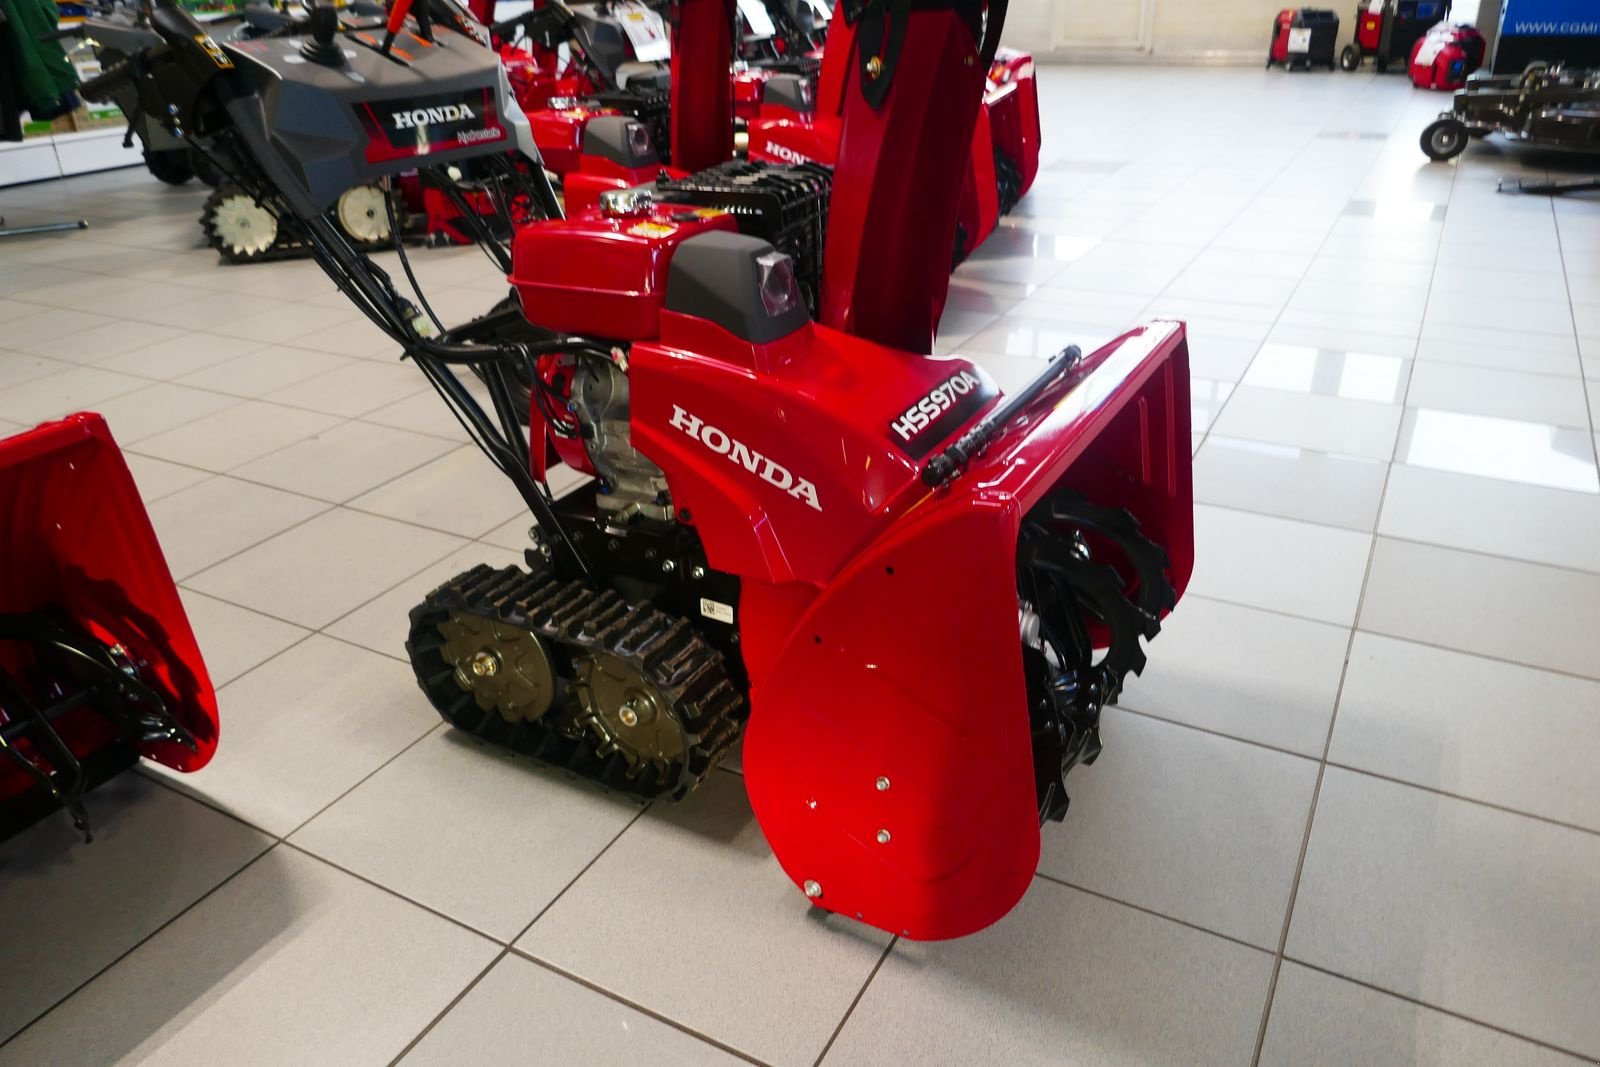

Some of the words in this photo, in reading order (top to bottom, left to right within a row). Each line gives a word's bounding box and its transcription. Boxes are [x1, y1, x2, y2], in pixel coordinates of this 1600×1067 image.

[392, 103, 476, 129] HONDA
[891, 370, 979, 441] HSS970A
[669, 403, 823, 512] HONDA
